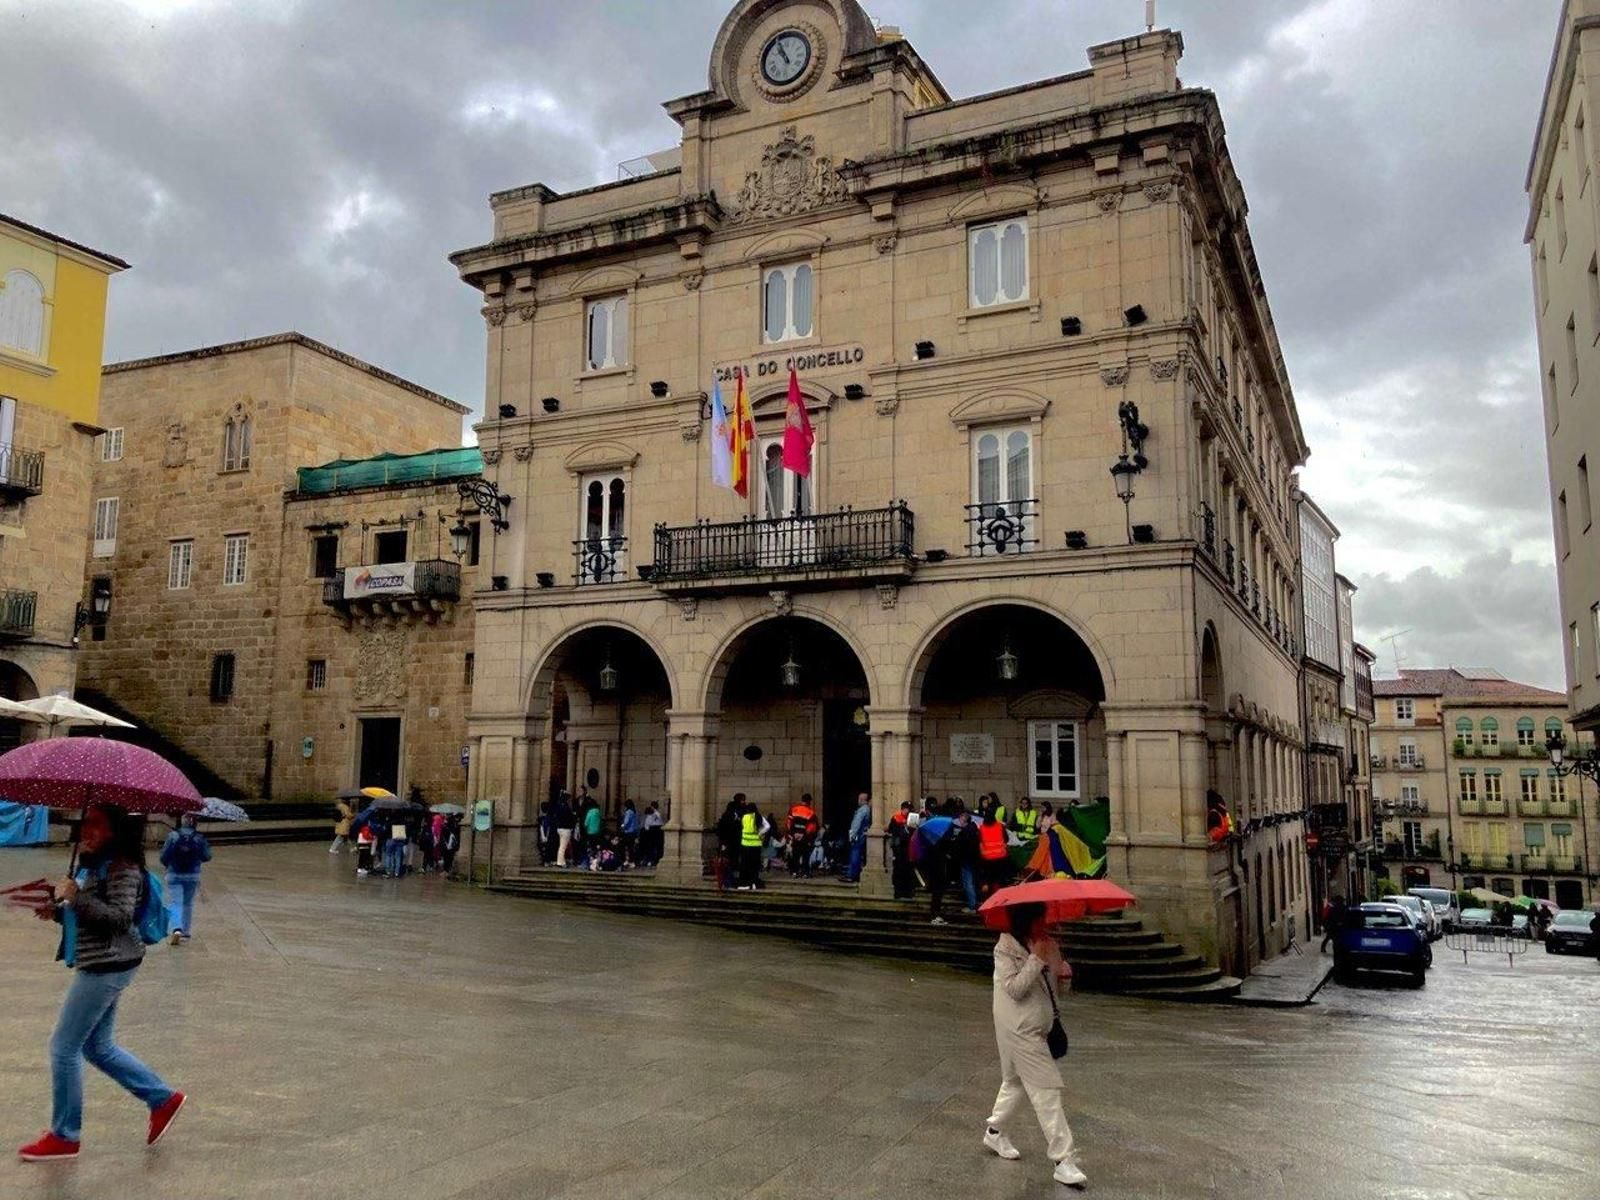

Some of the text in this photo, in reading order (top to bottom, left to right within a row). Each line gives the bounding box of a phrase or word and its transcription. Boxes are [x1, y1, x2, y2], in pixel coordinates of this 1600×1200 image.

[758, 361, 778, 376] DO
[786, 348, 864, 371] CONCELLO
[369, 576, 403, 588] COPASA
